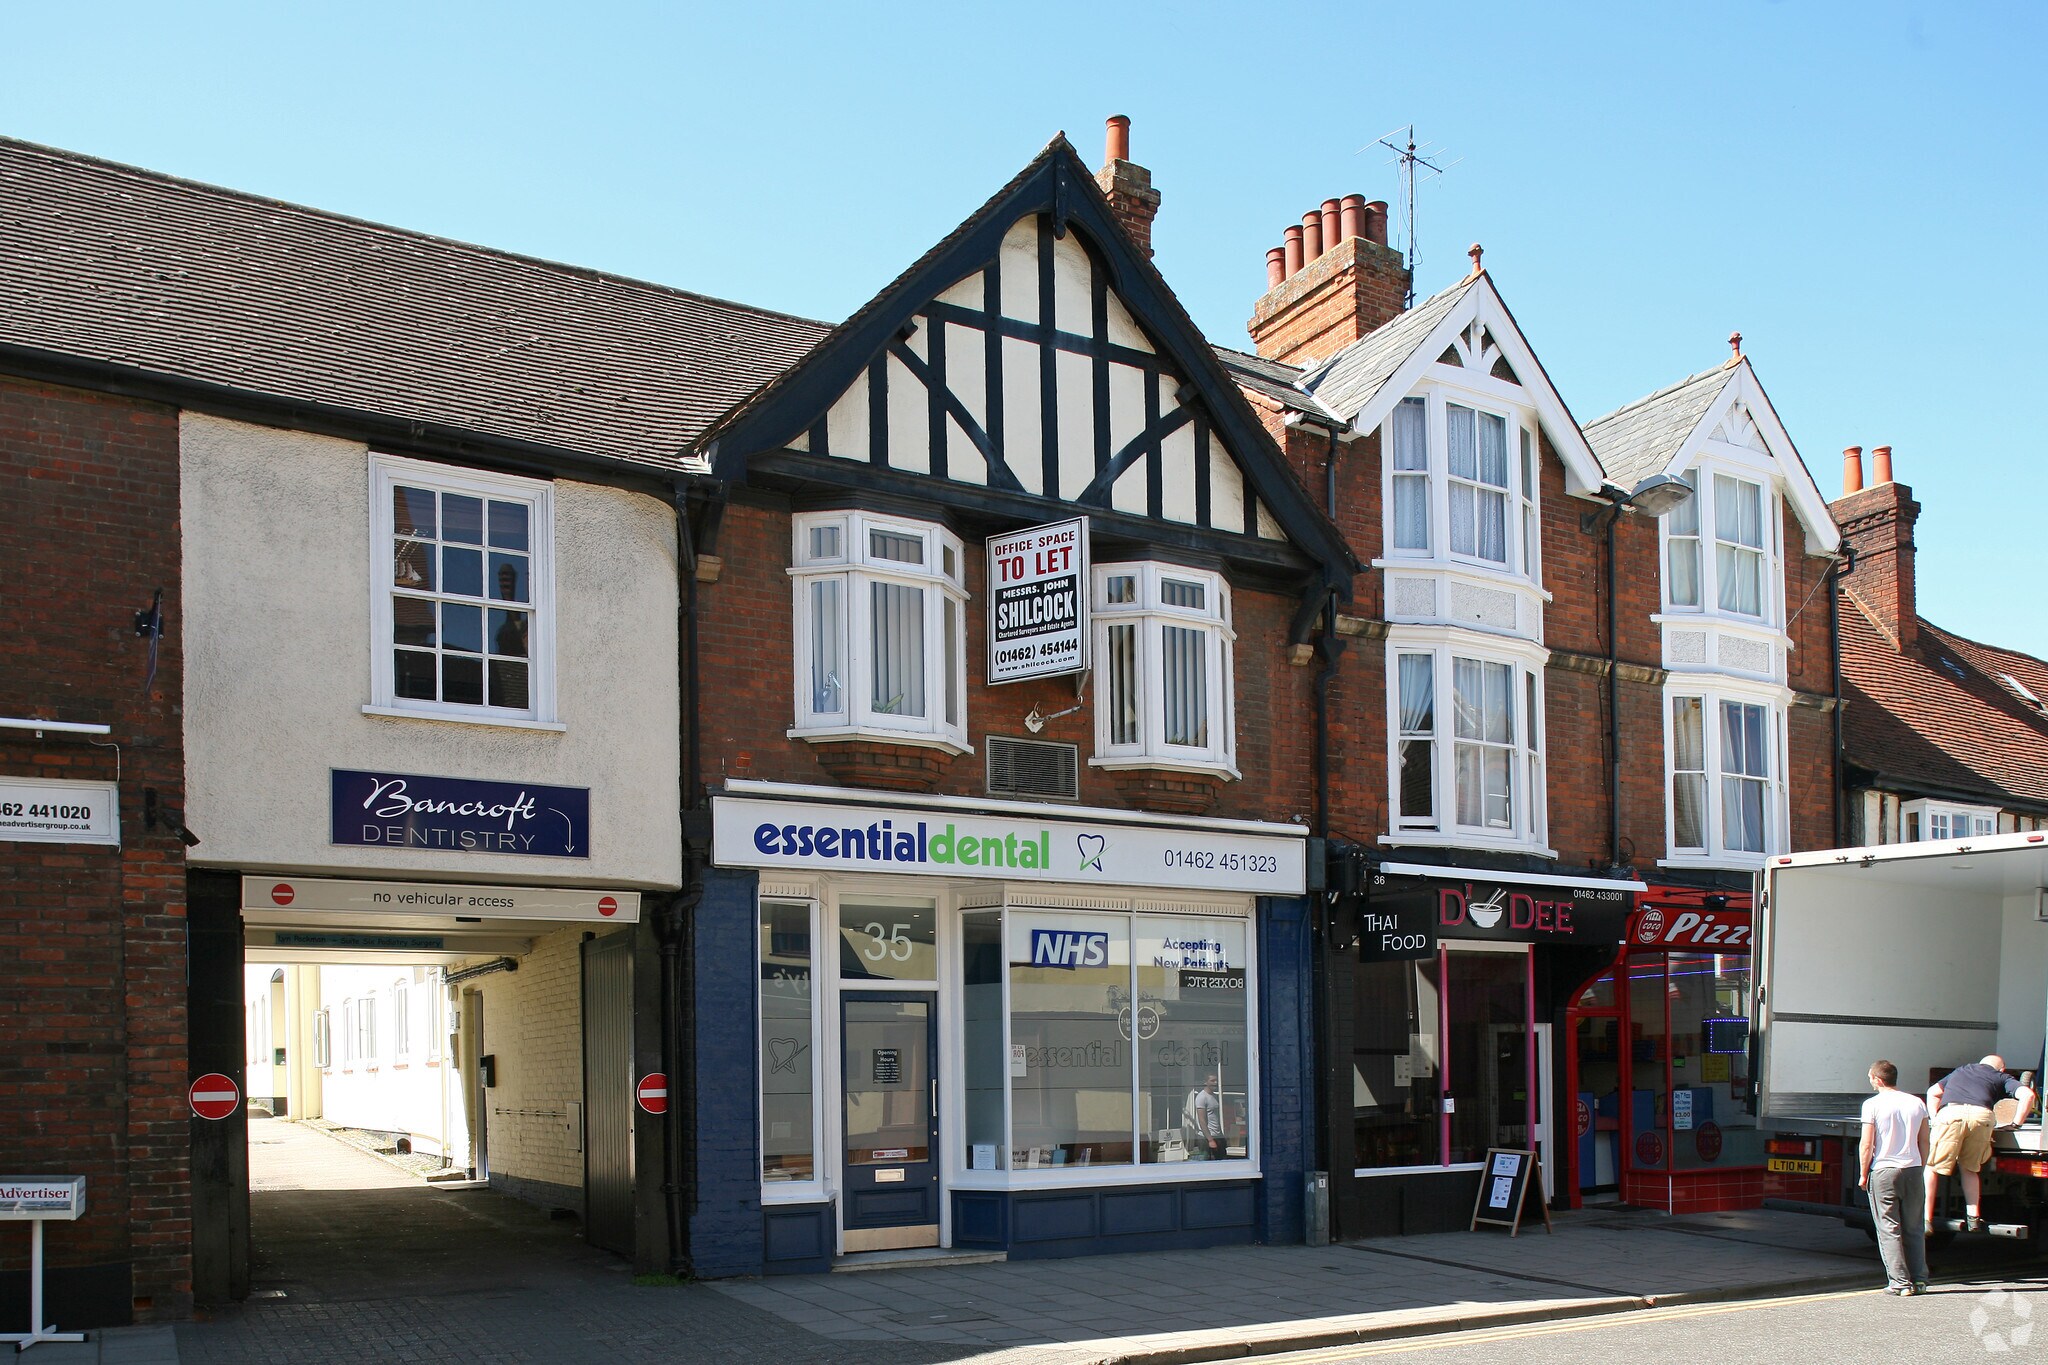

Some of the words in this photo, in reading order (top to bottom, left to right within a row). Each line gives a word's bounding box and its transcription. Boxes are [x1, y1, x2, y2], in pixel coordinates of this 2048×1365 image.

[995, 540, 1032, 556] OFFICE
[1039, 531, 1075, 548] SPACE
[998, 556, 1024, 582] TO
[1036, 546, 1072, 576] LET
[1003, 585, 1040, 599] MESSRS.
[1043, 579, 1068, 593] JOHN
[998, 590, 1074, 630] SHILCOCK
[998, 629, 1018, 638] Chartered
[1019, 627, 1038, 635] Surveyors
[1047, 622, 1059, 630] Estate
[1061, 620, 1074, 629] Agents
[995, 644, 1036, 665] (01462)
[1040, 638, 1078, 656] 454144
[998, 656, 1075, 672] www.shilcock.com
[29, 804, 91, 819] 441020
[363, 778, 535, 830] Bancroft
[363, 824, 535, 850] DENTISTRY
[1164, 849, 1214, 869] 01462
[1219, 853, 1277, 873] 451323
[1373, 875, 1385, 885] 36
[373, 894, 391, 904] no
[398, 893, 463, 906] vehicular
[468, 896, 514, 908] access
[1573, 889, 1595, 899] 01462
[1597, 890, 1623, 901] 433001
[1509, 893, 1574, 933] DEE
[1646, 912, 1661, 921] PIZZA
[1364, 914, 1398, 931] THAI
[1664, 912, 1752, 945] Pizz
[411, 939, 441, 948] Surgery
[864, 921, 912, 962] 35
[1035, 933, 1106, 966] NHS
[1163, 937, 1221, 954] Accepting
[1382, 934, 1426, 952] FOOD
[1154, 956, 1179, 969] New
[1184, 957, 1229, 971] Patients
[1026, 1041, 1122, 1068] essential
[1158, 1041, 1229, 1067] dental
[1774, 1160, 1794, 1171] LT10
[1797, 1162, 1815, 1171] MHJ
[0, 1187, 69, 1199] Advertiser
